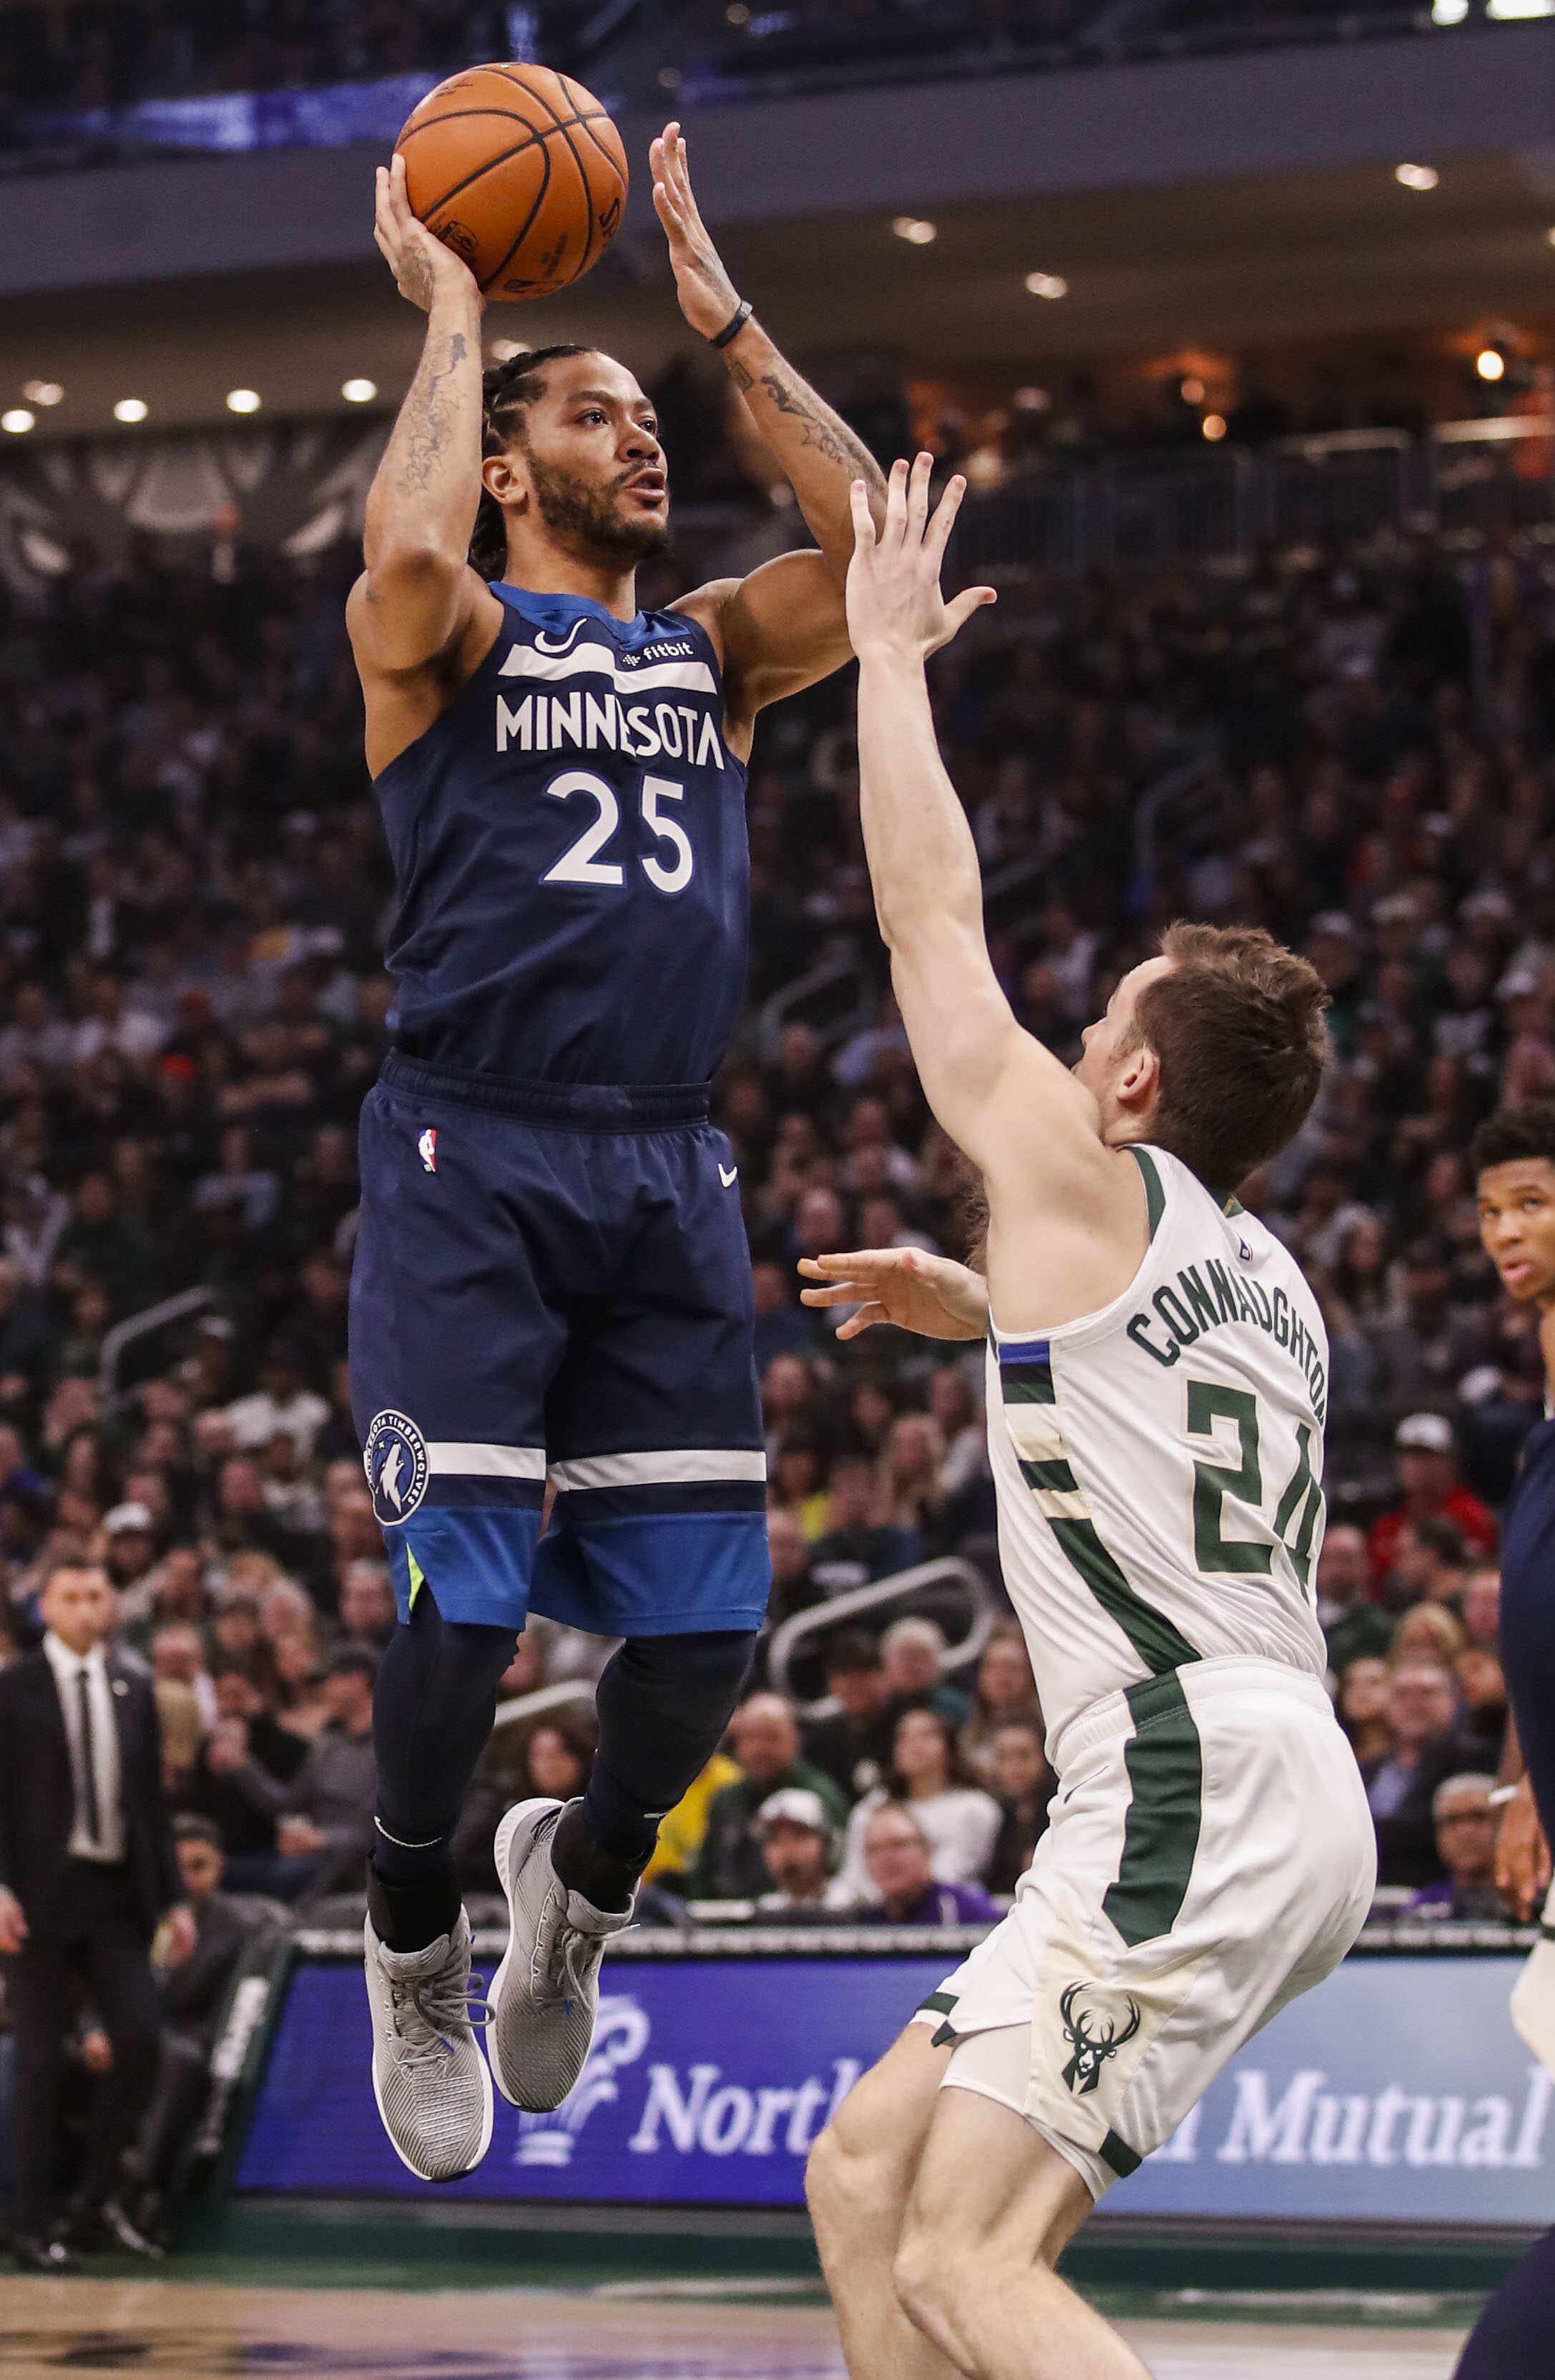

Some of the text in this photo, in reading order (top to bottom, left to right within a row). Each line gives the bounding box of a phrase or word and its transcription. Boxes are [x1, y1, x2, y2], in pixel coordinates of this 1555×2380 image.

[642, 642, 694, 660] fitbit
[541, 769, 694, 894] 25
[388, 1416, 426, 1505] TIMBERWOLVES
[1186, 1379, 1325, 1603] 24
[1217, 2065, 1554, 2168] Mutual
